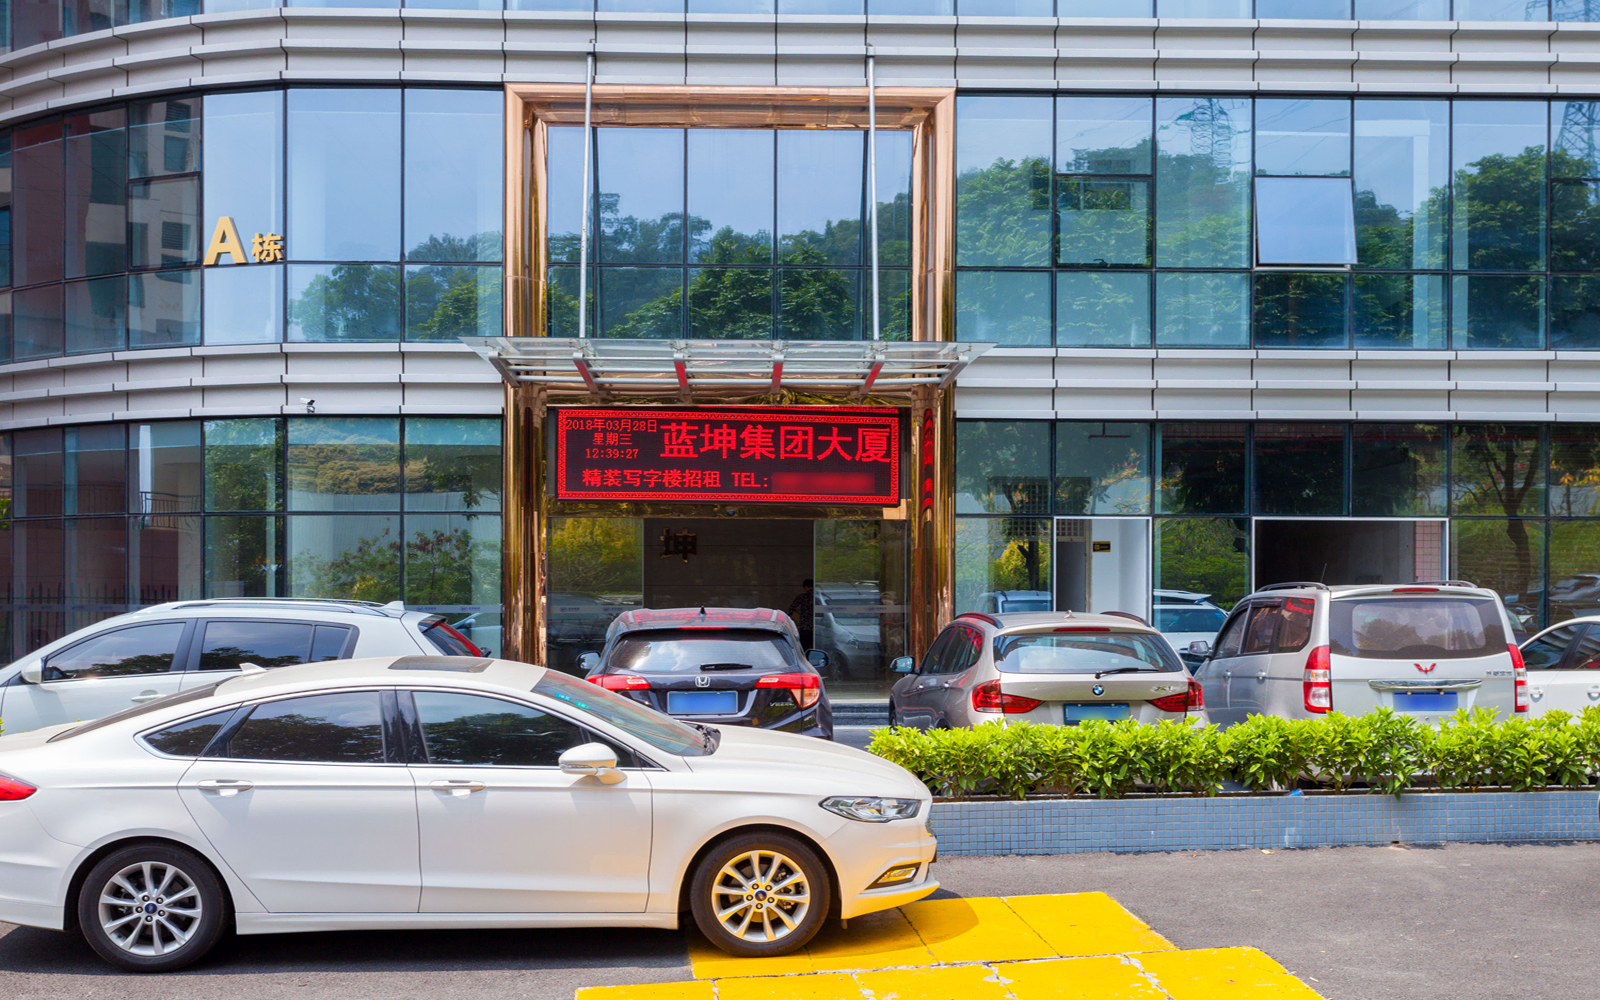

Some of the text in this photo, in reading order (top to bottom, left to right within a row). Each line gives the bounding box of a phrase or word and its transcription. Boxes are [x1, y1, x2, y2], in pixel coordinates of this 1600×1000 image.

[202, 216, 284, 266] A栋
[565, 417, 658, 433] 2018年03月28日
[592, 431, 633, 446] 星期三
[660, 422, 892, 462] 蓝坤集团大厦
[585, 447, 640, 459] 12:39:27
[582, 469, 721, 488] 精装写字楼招租
[731, 471, 768, 488] TEL:
